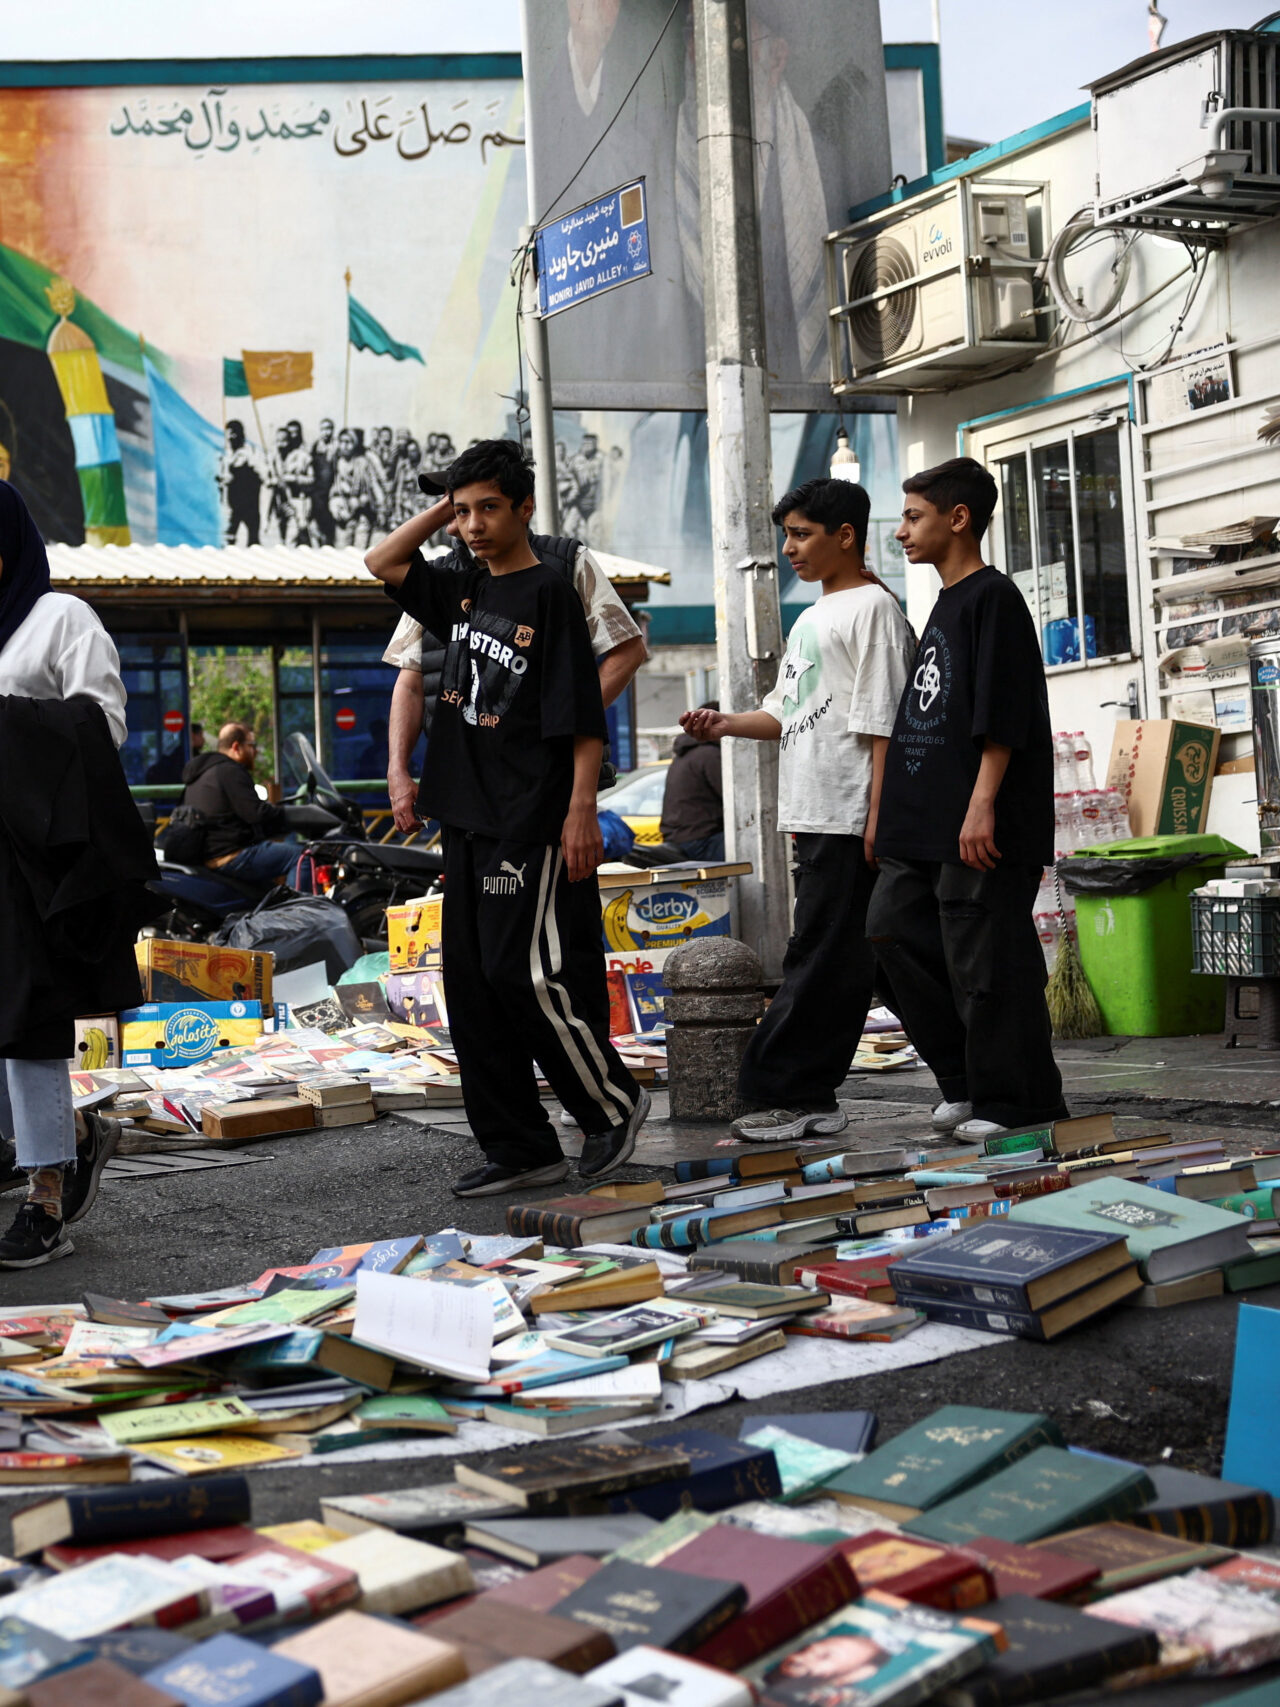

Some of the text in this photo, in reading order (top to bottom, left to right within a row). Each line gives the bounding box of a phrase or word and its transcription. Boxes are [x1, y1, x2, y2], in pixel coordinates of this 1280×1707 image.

[548, 226, 619, 282] منیری جاوید
[922, 237, 953, 263] evvoli
[548, 264, 623, 306] MONIRI JAVID ALLEY
[483, 875, 517, 895] PUMA
[640, 894, 694, 919] derby
[254, 956, 264, 1000] BASTIANO
[165, 1024, 220, 1059] golosita
